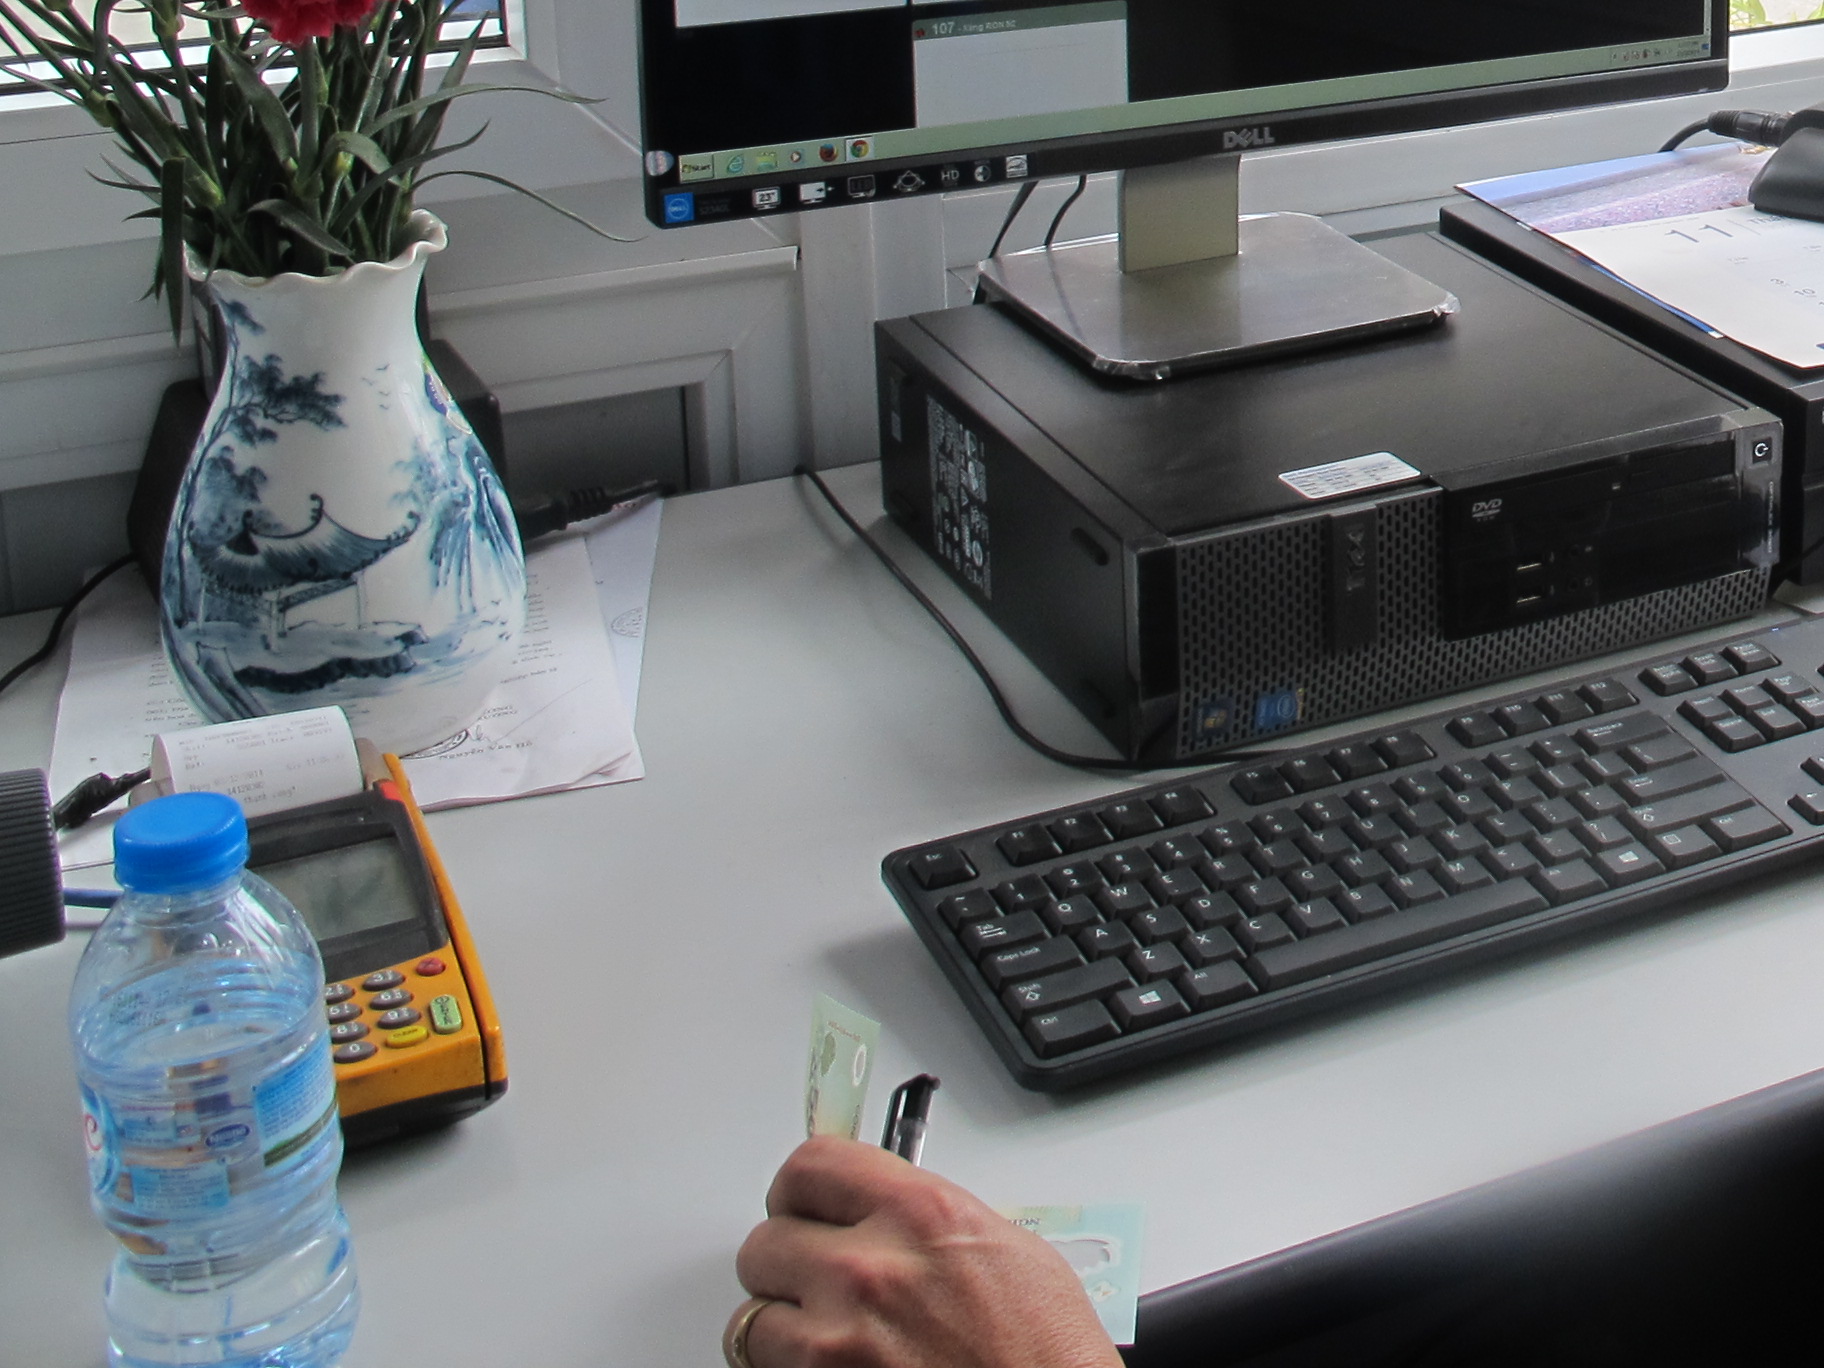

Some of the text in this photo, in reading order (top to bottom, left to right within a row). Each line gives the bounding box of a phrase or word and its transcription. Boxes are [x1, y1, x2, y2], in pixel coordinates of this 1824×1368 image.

[932, 22, 955, 35] 107
[1223, 127, 1275, 149] DELL
[1472, 498, 1503, 513] DVD
